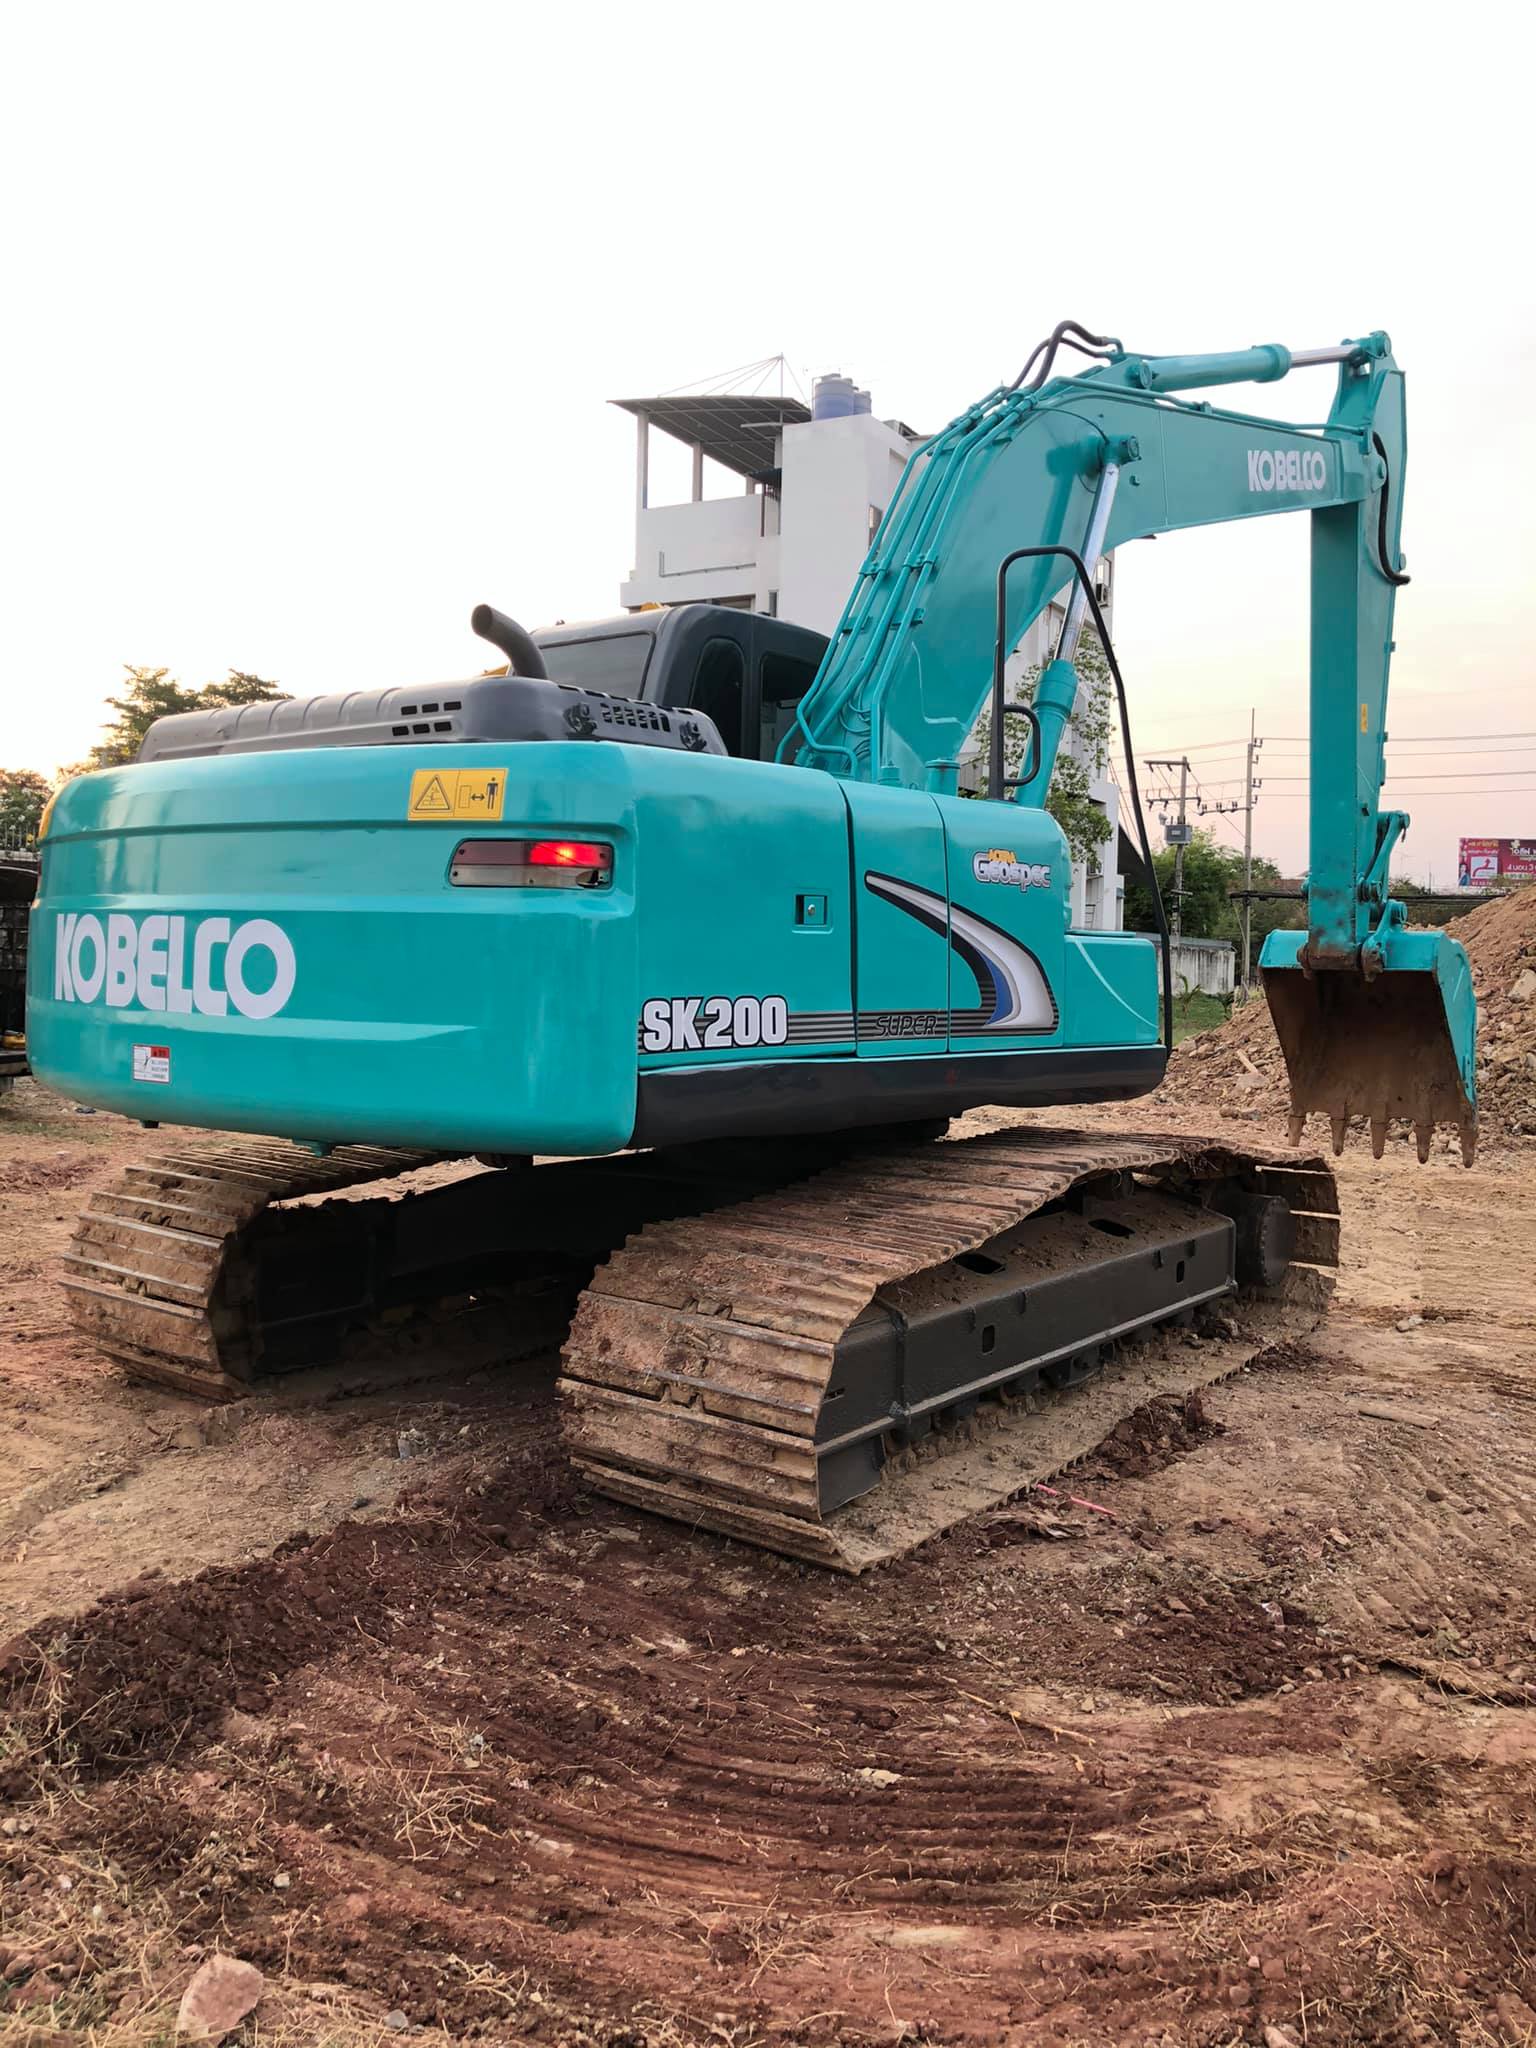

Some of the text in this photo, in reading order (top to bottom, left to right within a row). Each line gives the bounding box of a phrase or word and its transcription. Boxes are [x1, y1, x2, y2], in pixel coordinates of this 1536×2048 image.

[1247, 449, 1326, 492] KOBELCO
[55, 913, 297, 1020] KOBELCO
[642, 995, 789, 1053] SK200
[876, 1015, 937, 1037] SUPER
